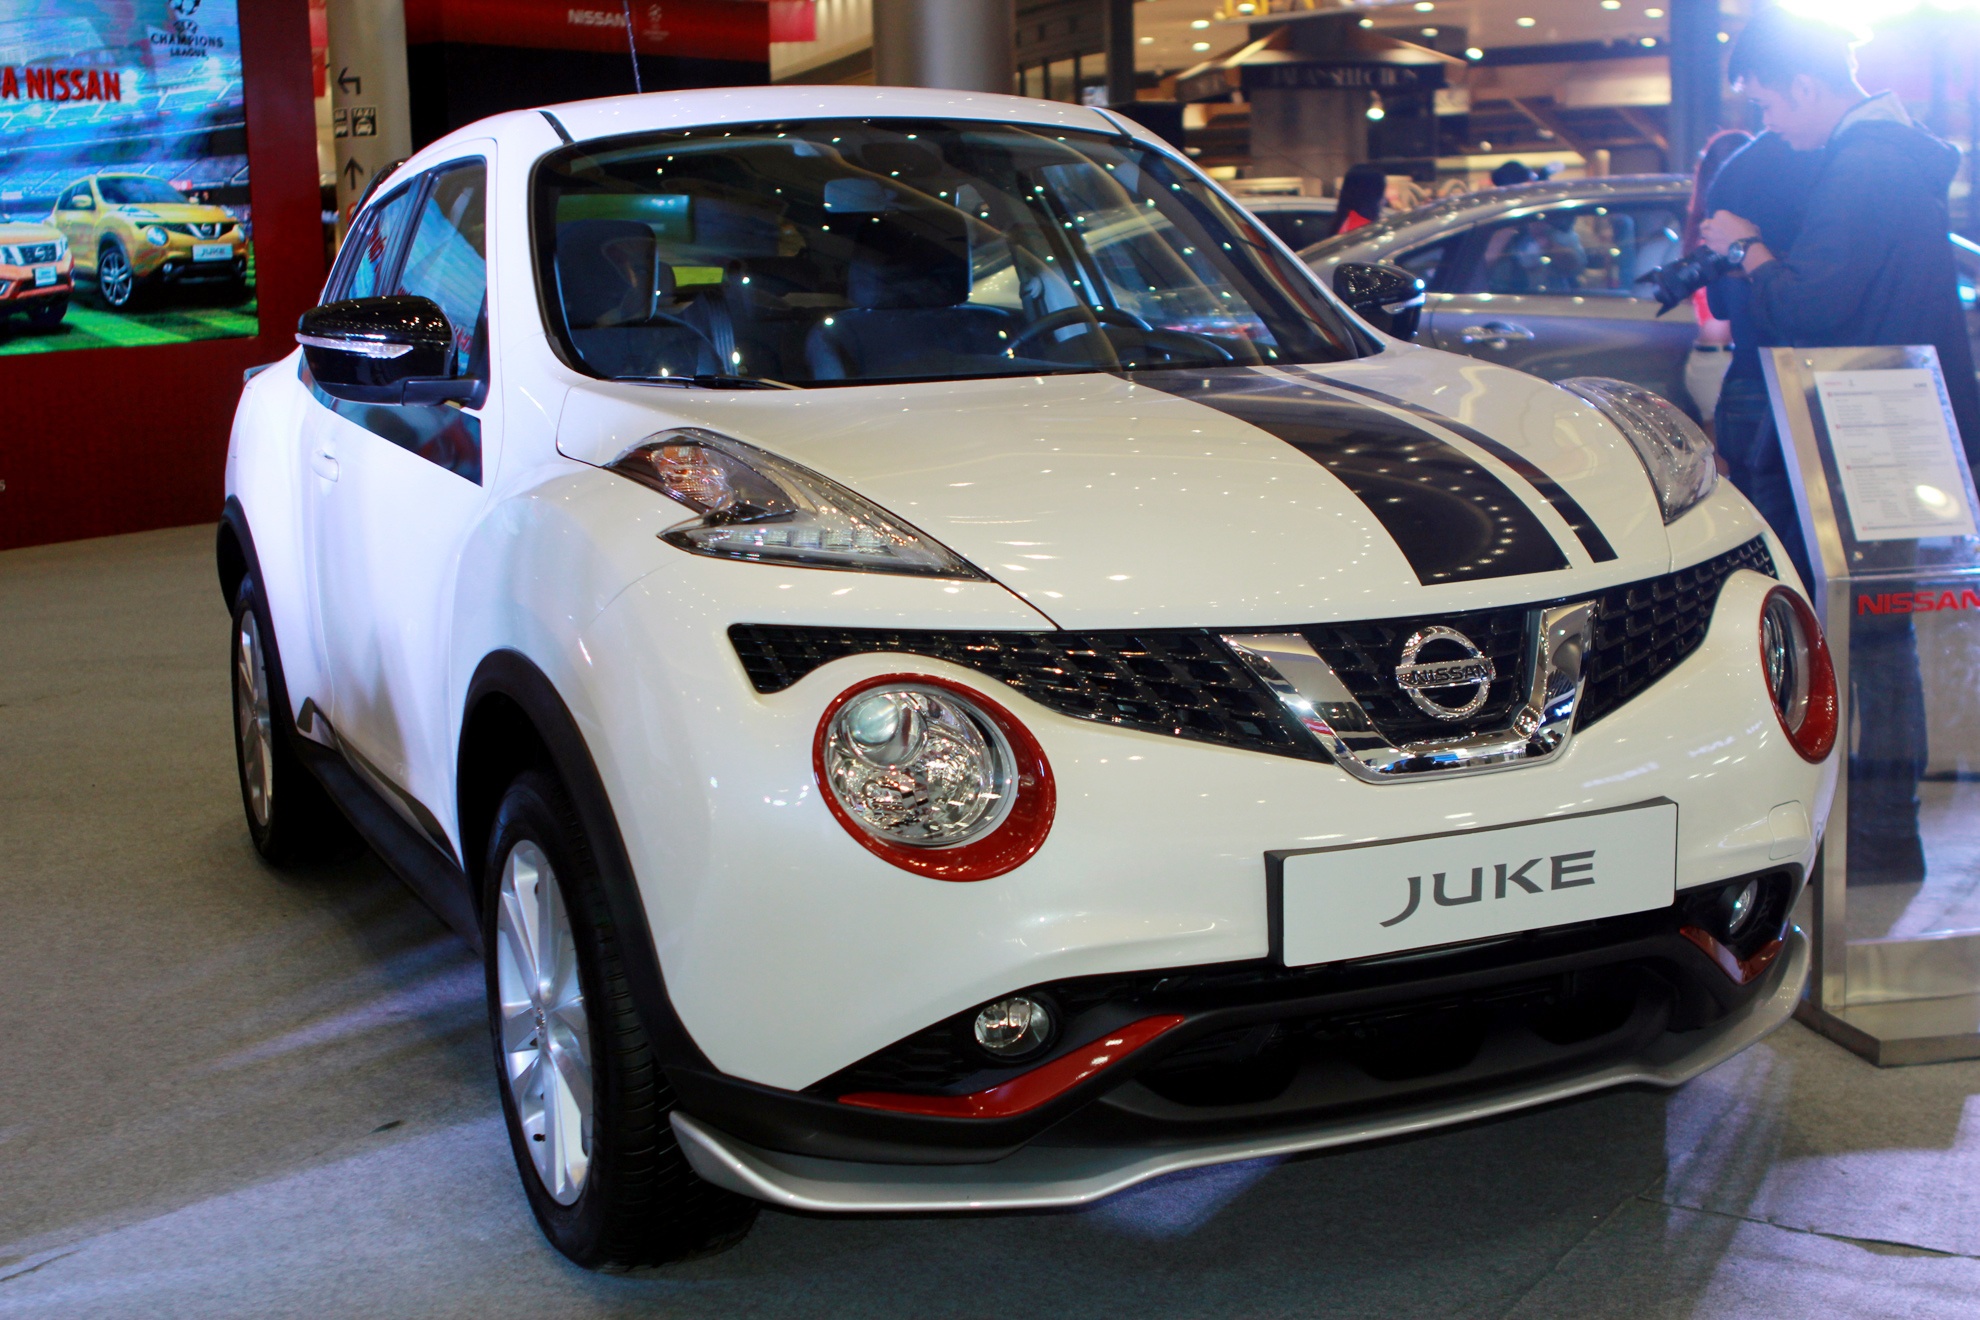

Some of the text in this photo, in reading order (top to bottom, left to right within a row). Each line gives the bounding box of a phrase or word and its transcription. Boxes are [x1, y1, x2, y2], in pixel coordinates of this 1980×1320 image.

[568, 9, 626, 28] NISSAN
[150, 33, 224, 48] CHAMPIONS
[169, 47, 208, 57] LEAGUE
[25, 67, 121, 101] NISSAN
[1857, 589, 1980, 616] NISSAN
[1411, 663, 1489, 685] NISSAN
[1379, 849, 1597, 929] JUKE
